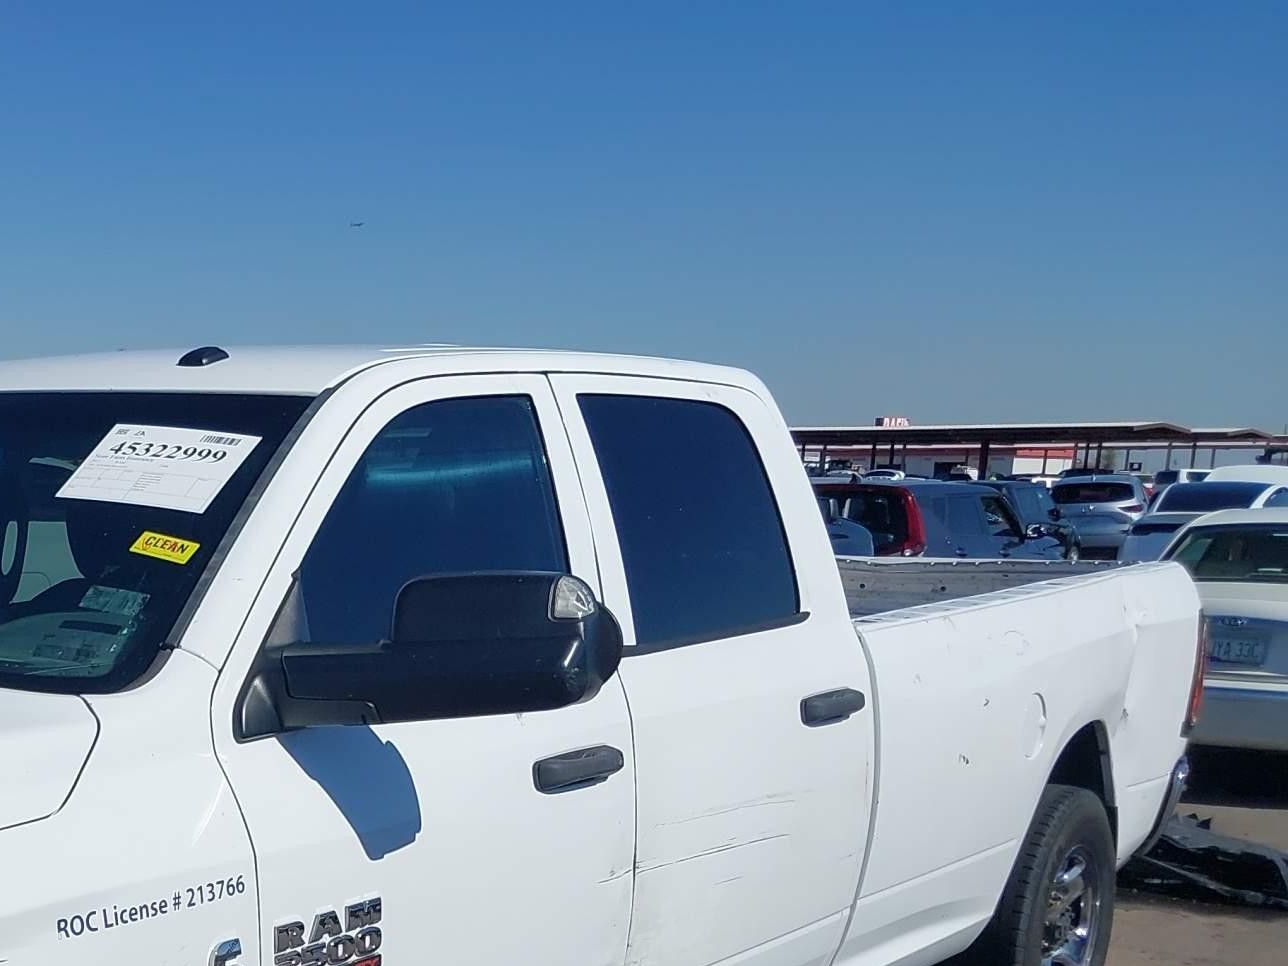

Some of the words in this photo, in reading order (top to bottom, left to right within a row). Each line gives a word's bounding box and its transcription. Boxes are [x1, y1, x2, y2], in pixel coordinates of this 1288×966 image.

[109, 441, 228, 463] 45322999
[145, 536, 189, 555] CLEAN
[57, 911, 98, 938] ROC
[103, 900, 168, 928] License
[173, 891, 182, 911] #
[186, 875, 245, 907] 213766
[273, 897, 382, 953] RAM
